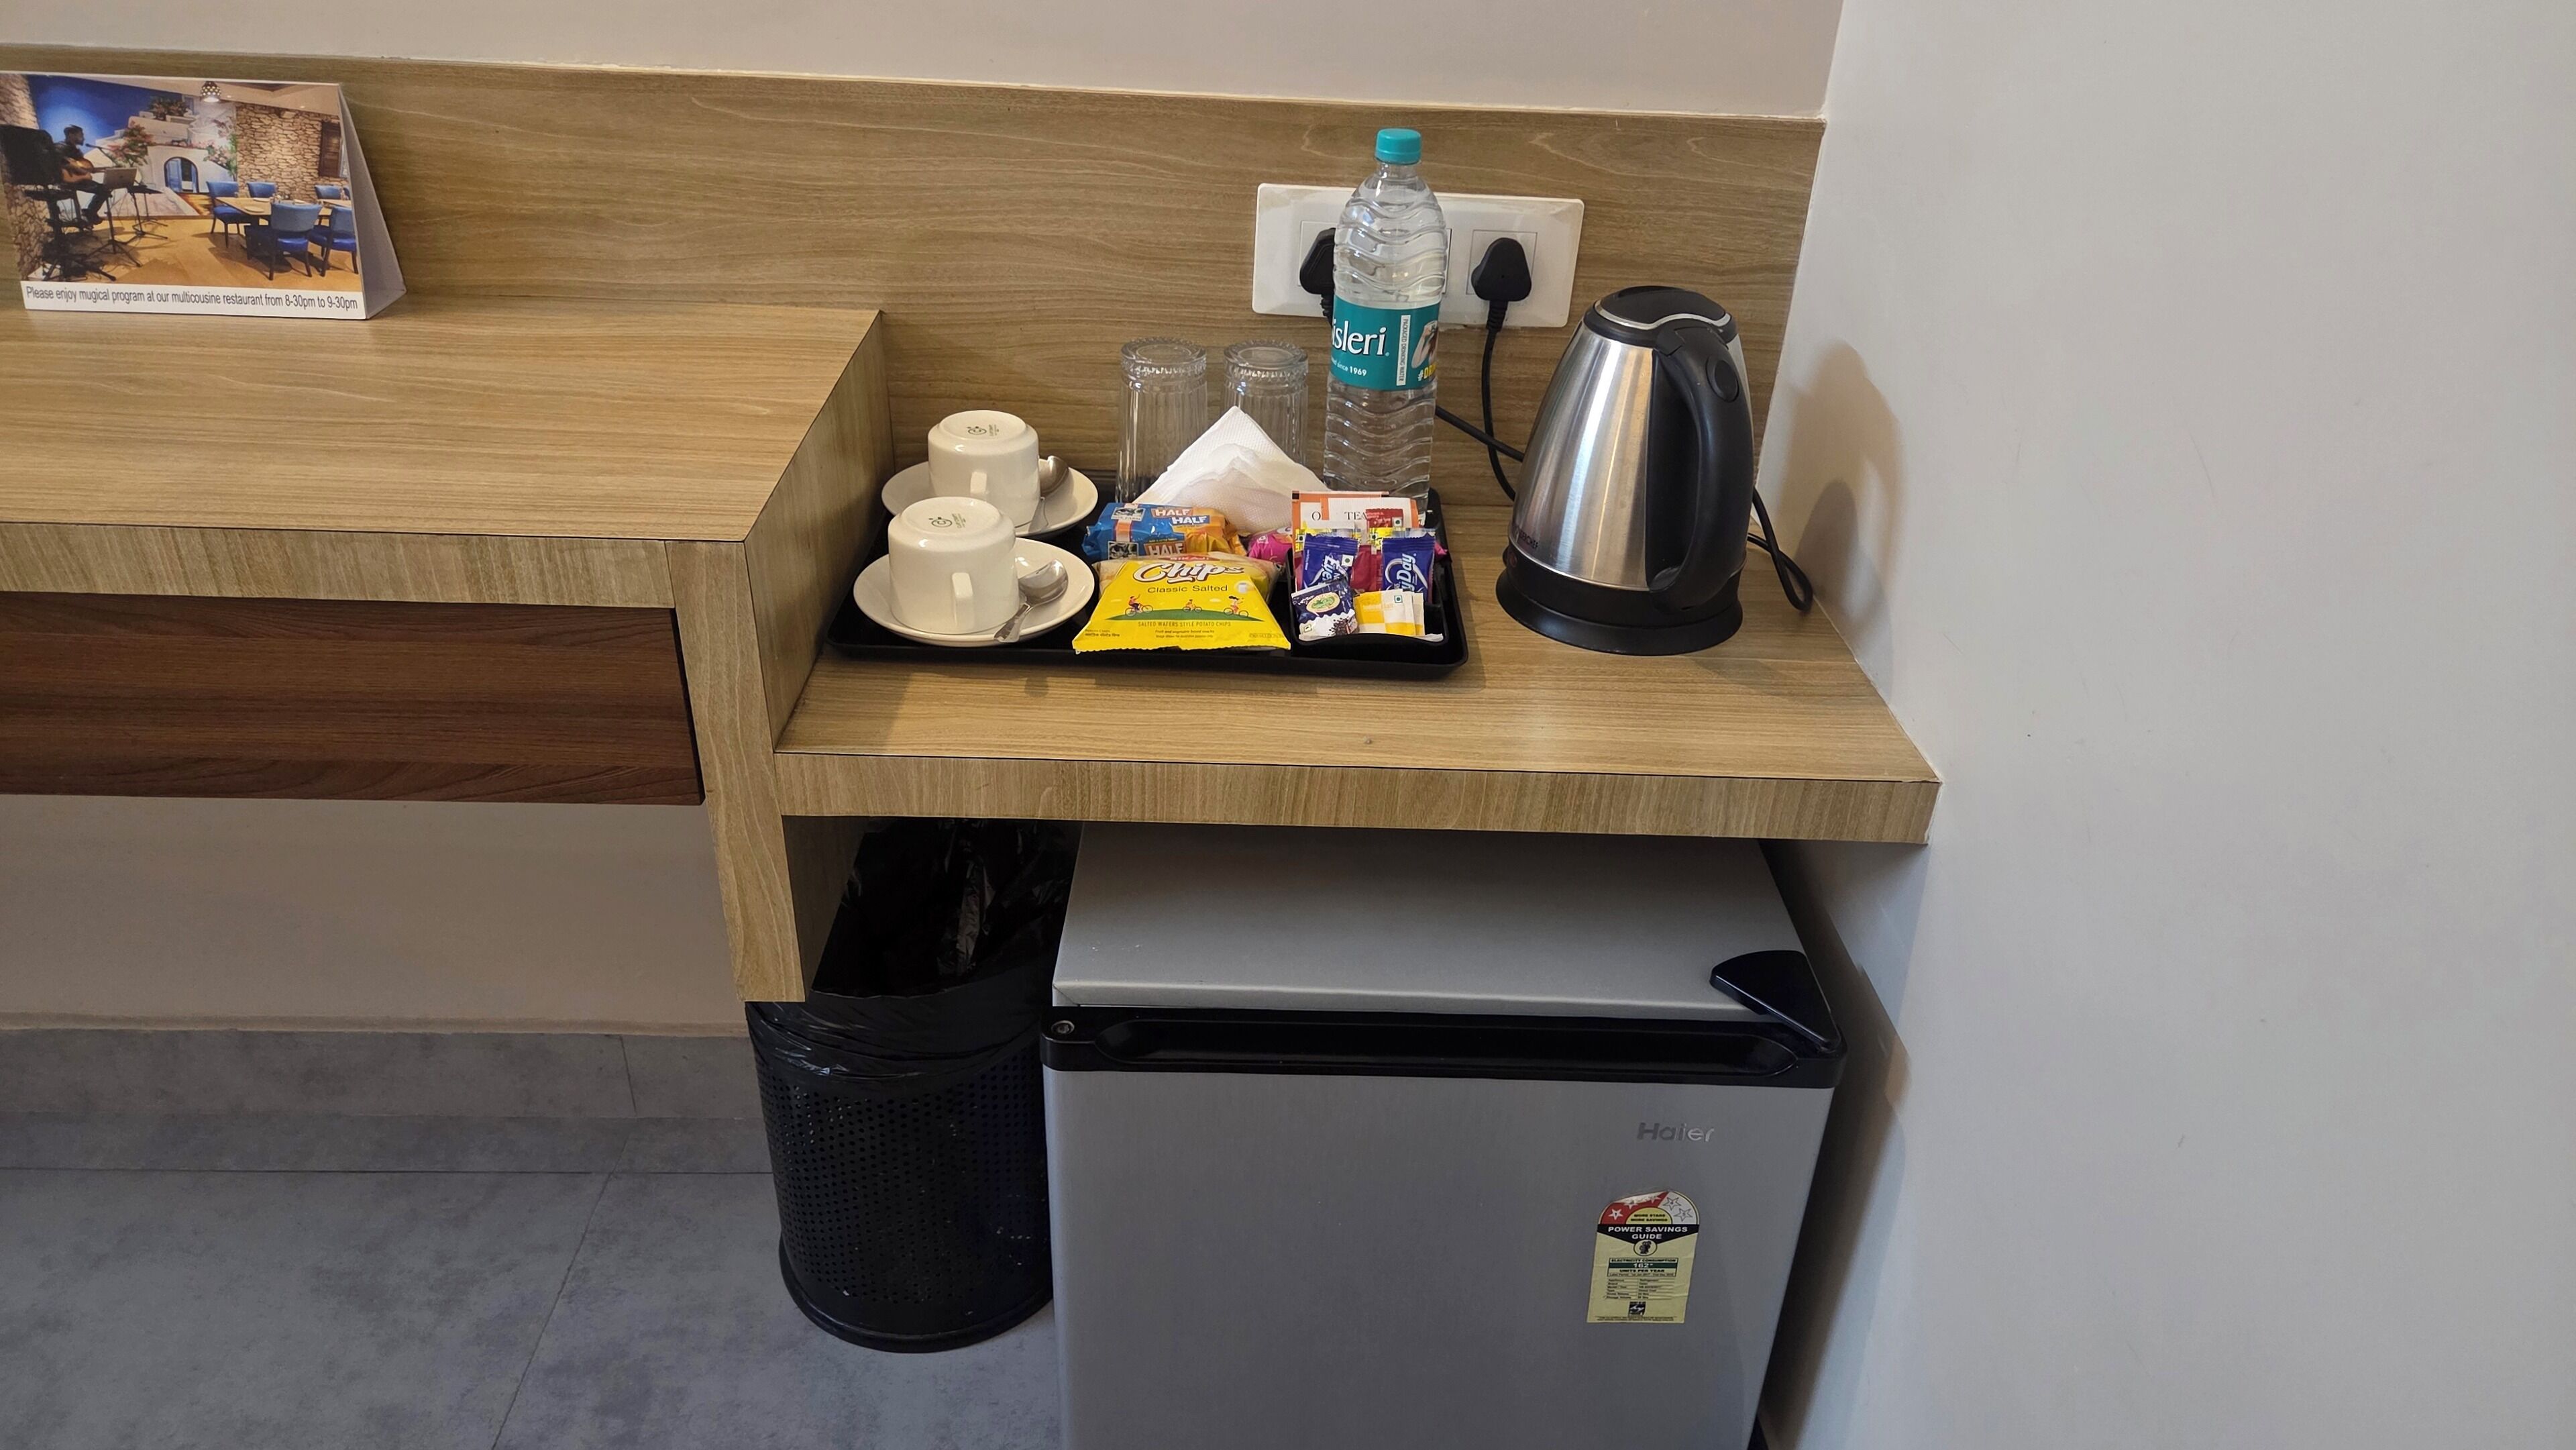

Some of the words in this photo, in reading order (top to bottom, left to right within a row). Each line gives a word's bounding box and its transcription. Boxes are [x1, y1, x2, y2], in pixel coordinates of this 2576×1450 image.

[26, 286, 54, 299] Please
[56, 287, 76, 303] enjoy
[79, 288, 110, 303] mugical
[112, 291, 145, 305] program
[147, 291, 154, 302] at
[156, 293, 169, 303] our
[172, 291, 221, 304] multicousine
[223, 293, 264, 306] restaurant
[265, 293, 283, 307] from
[285, 295, 315, 309] 8-30pm
[317, 297, 325, 308] to
[327, 296, 358, 311] 9-30pm
[1401, 319, 1409, 343] PACKAGED
[1350, 366, 1367, 376] 1969
[1155, 508, 1191, 517] HALF
[1172, 515, 1208, 524] HALF
[1148, 543, 1183, 556] HALF
[1132, 562, 1245, 584] Chips
[1637, 1122, 1715, 1142] Haier
